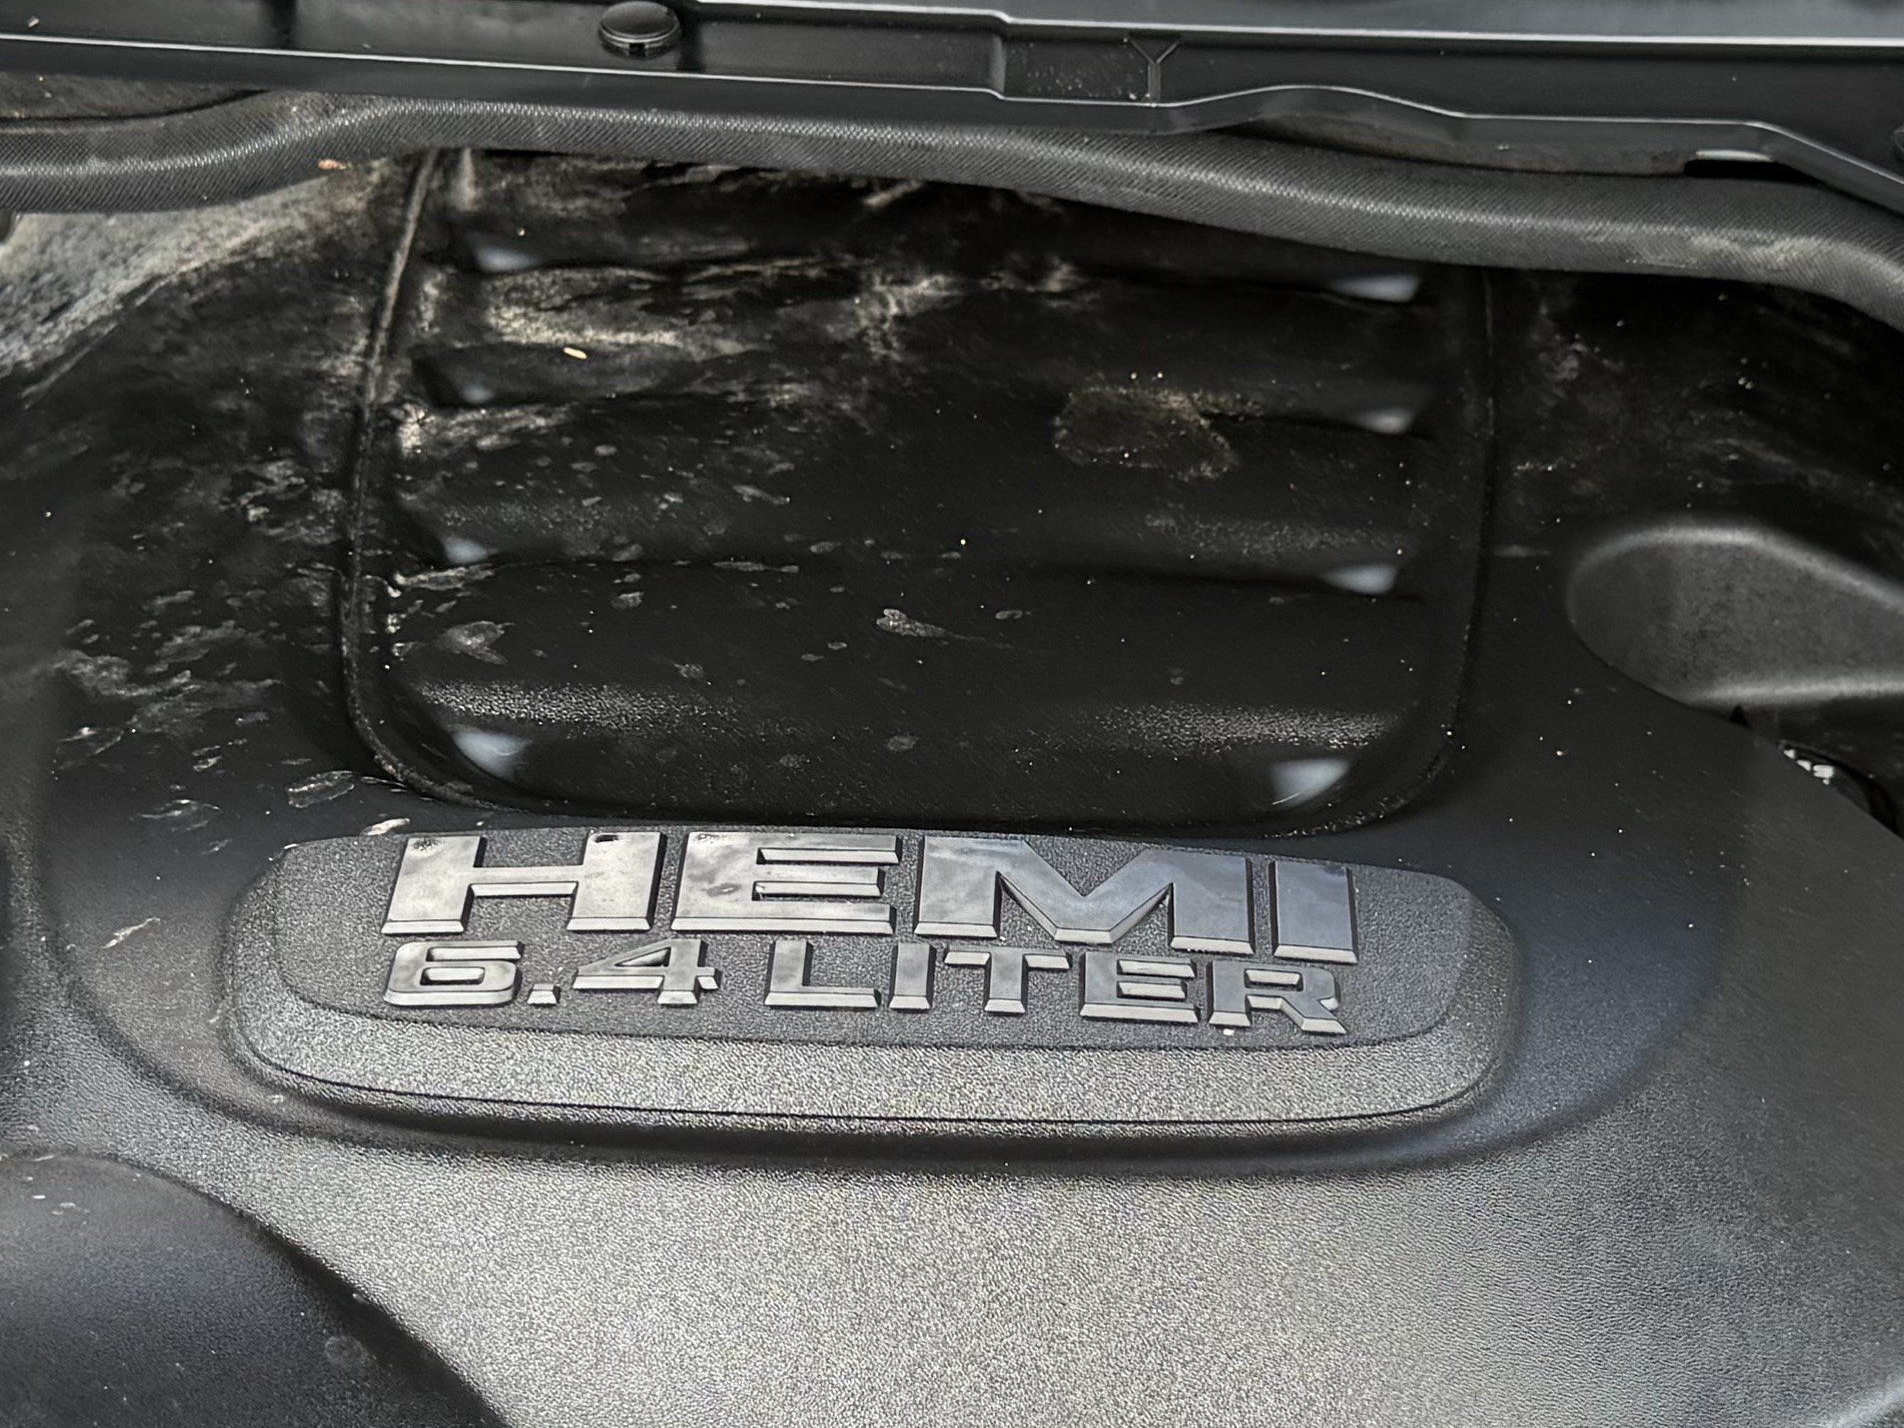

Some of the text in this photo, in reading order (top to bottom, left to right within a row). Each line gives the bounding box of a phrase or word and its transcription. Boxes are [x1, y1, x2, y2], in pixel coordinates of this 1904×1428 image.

[381, 830, 1359, 964] HEMI
[383, 938, 1347, 1036] 6.4 LITER
